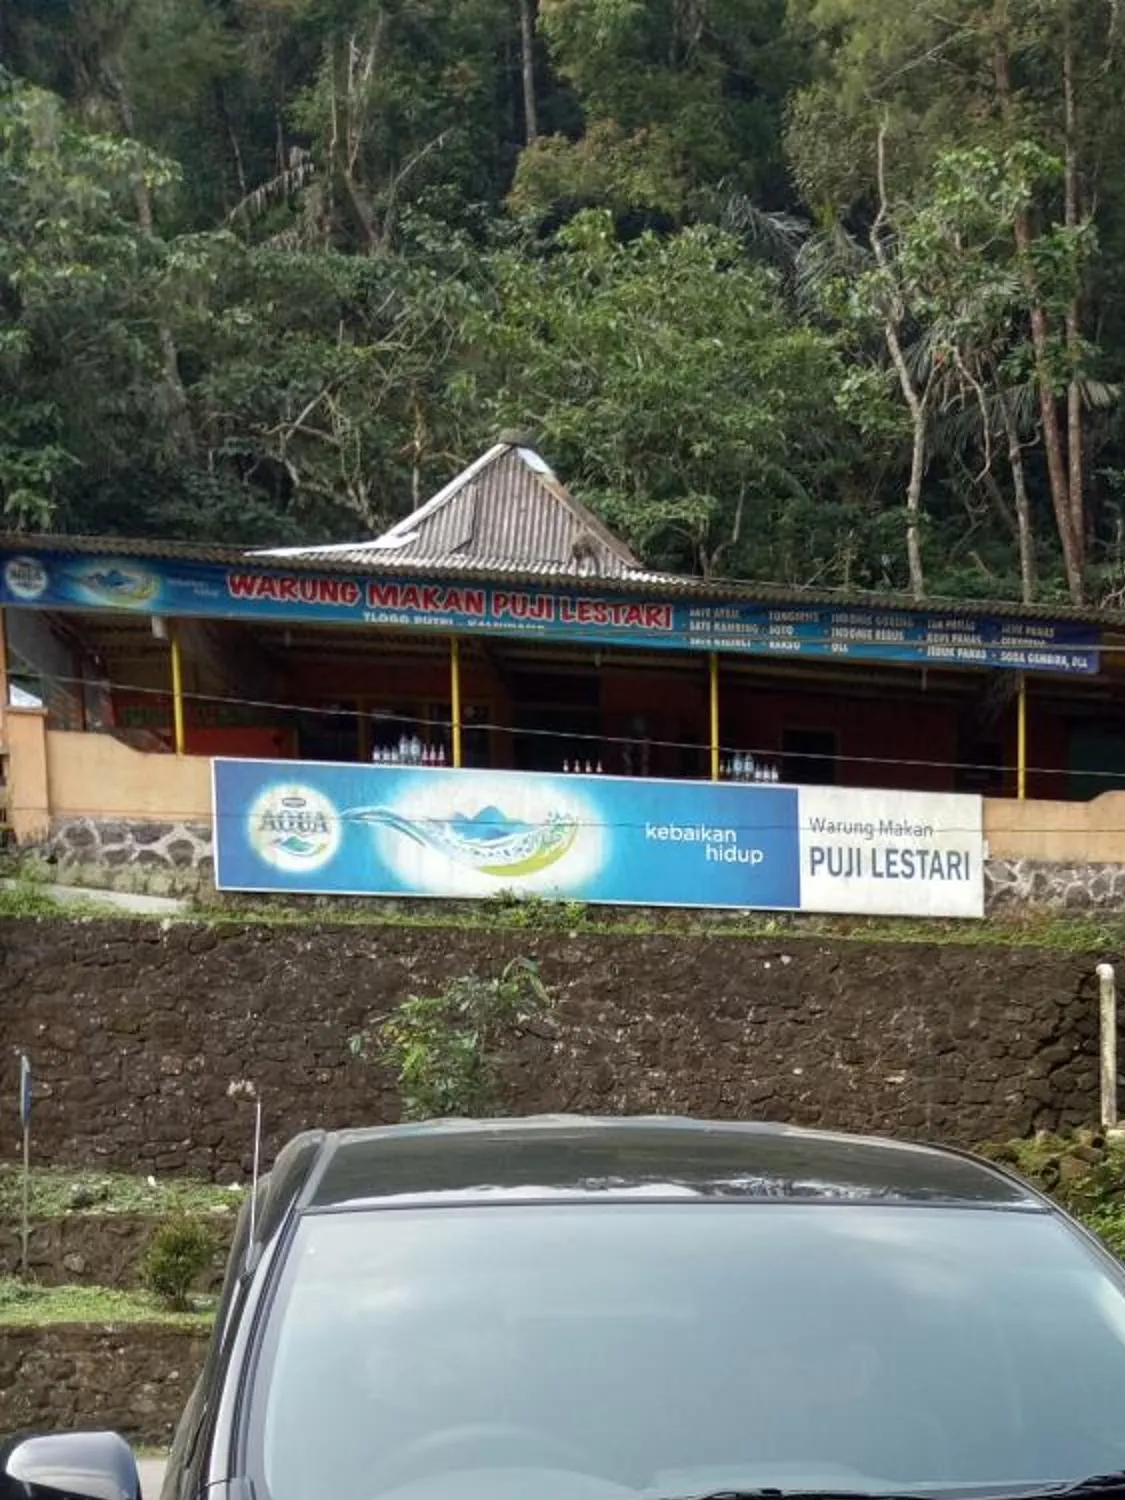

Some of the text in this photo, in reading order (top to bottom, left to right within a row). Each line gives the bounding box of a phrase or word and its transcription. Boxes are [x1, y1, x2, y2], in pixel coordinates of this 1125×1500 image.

[227, 572, 361, 607] WARUNG
[366, 580, 486, 617] MAKAN
[492, 589, 555, 622] PUJI
[559, 596, 673, 630] LESTARI
[258, 809, 331, 837] AQUA
[645, 822, 737, 843] kebaikan
[809, 817, 933, 841] Warung Makan
[706, 844, 764, 866] hidup
[810, 846, 970, 882] PUJI LESTARI
